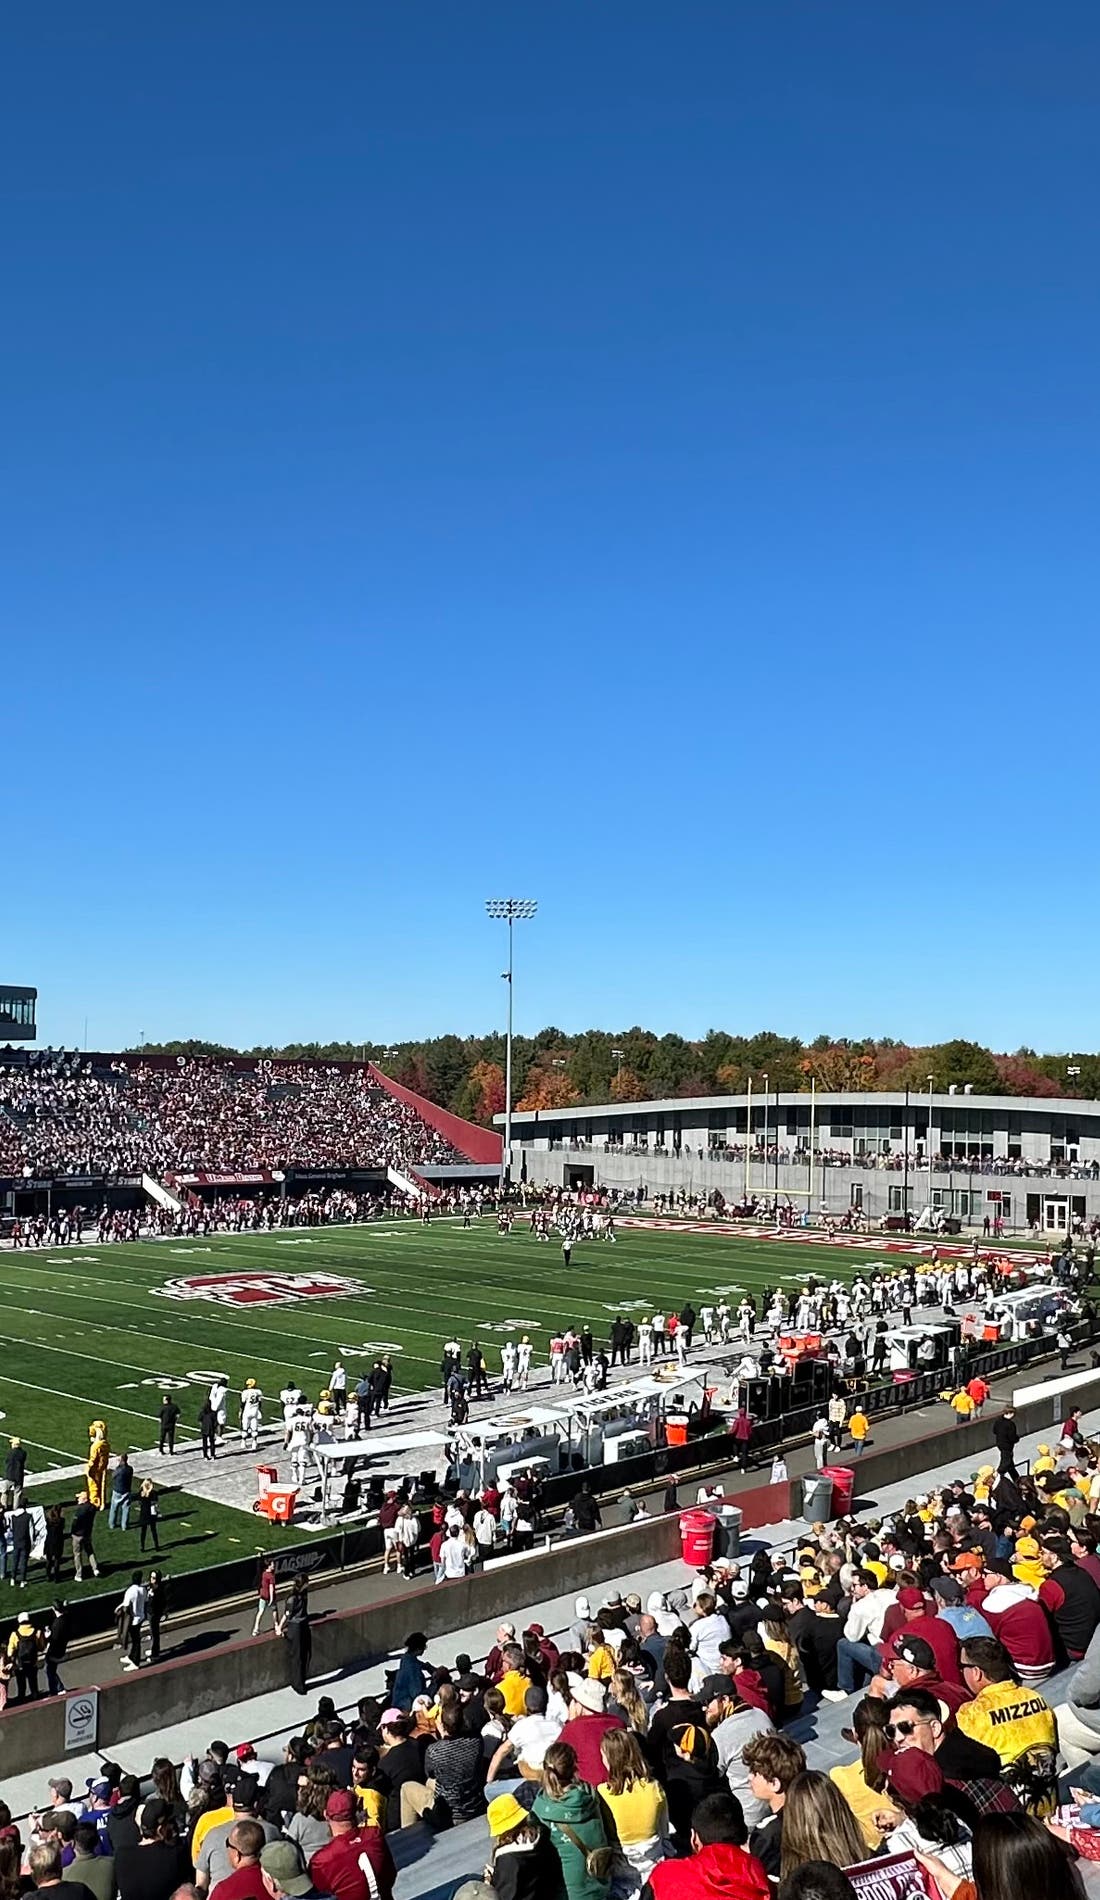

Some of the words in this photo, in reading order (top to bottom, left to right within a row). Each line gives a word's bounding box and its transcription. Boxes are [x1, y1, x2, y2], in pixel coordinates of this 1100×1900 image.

[176, 1056, 186, 1066] 9
[141, 1371, 230, 1390] 30
[573, 1389, 640, 1410] TIGERS
[272, 1498, 286, 1512] G
[989, 1696, 1048, 1726] MIZZOU
